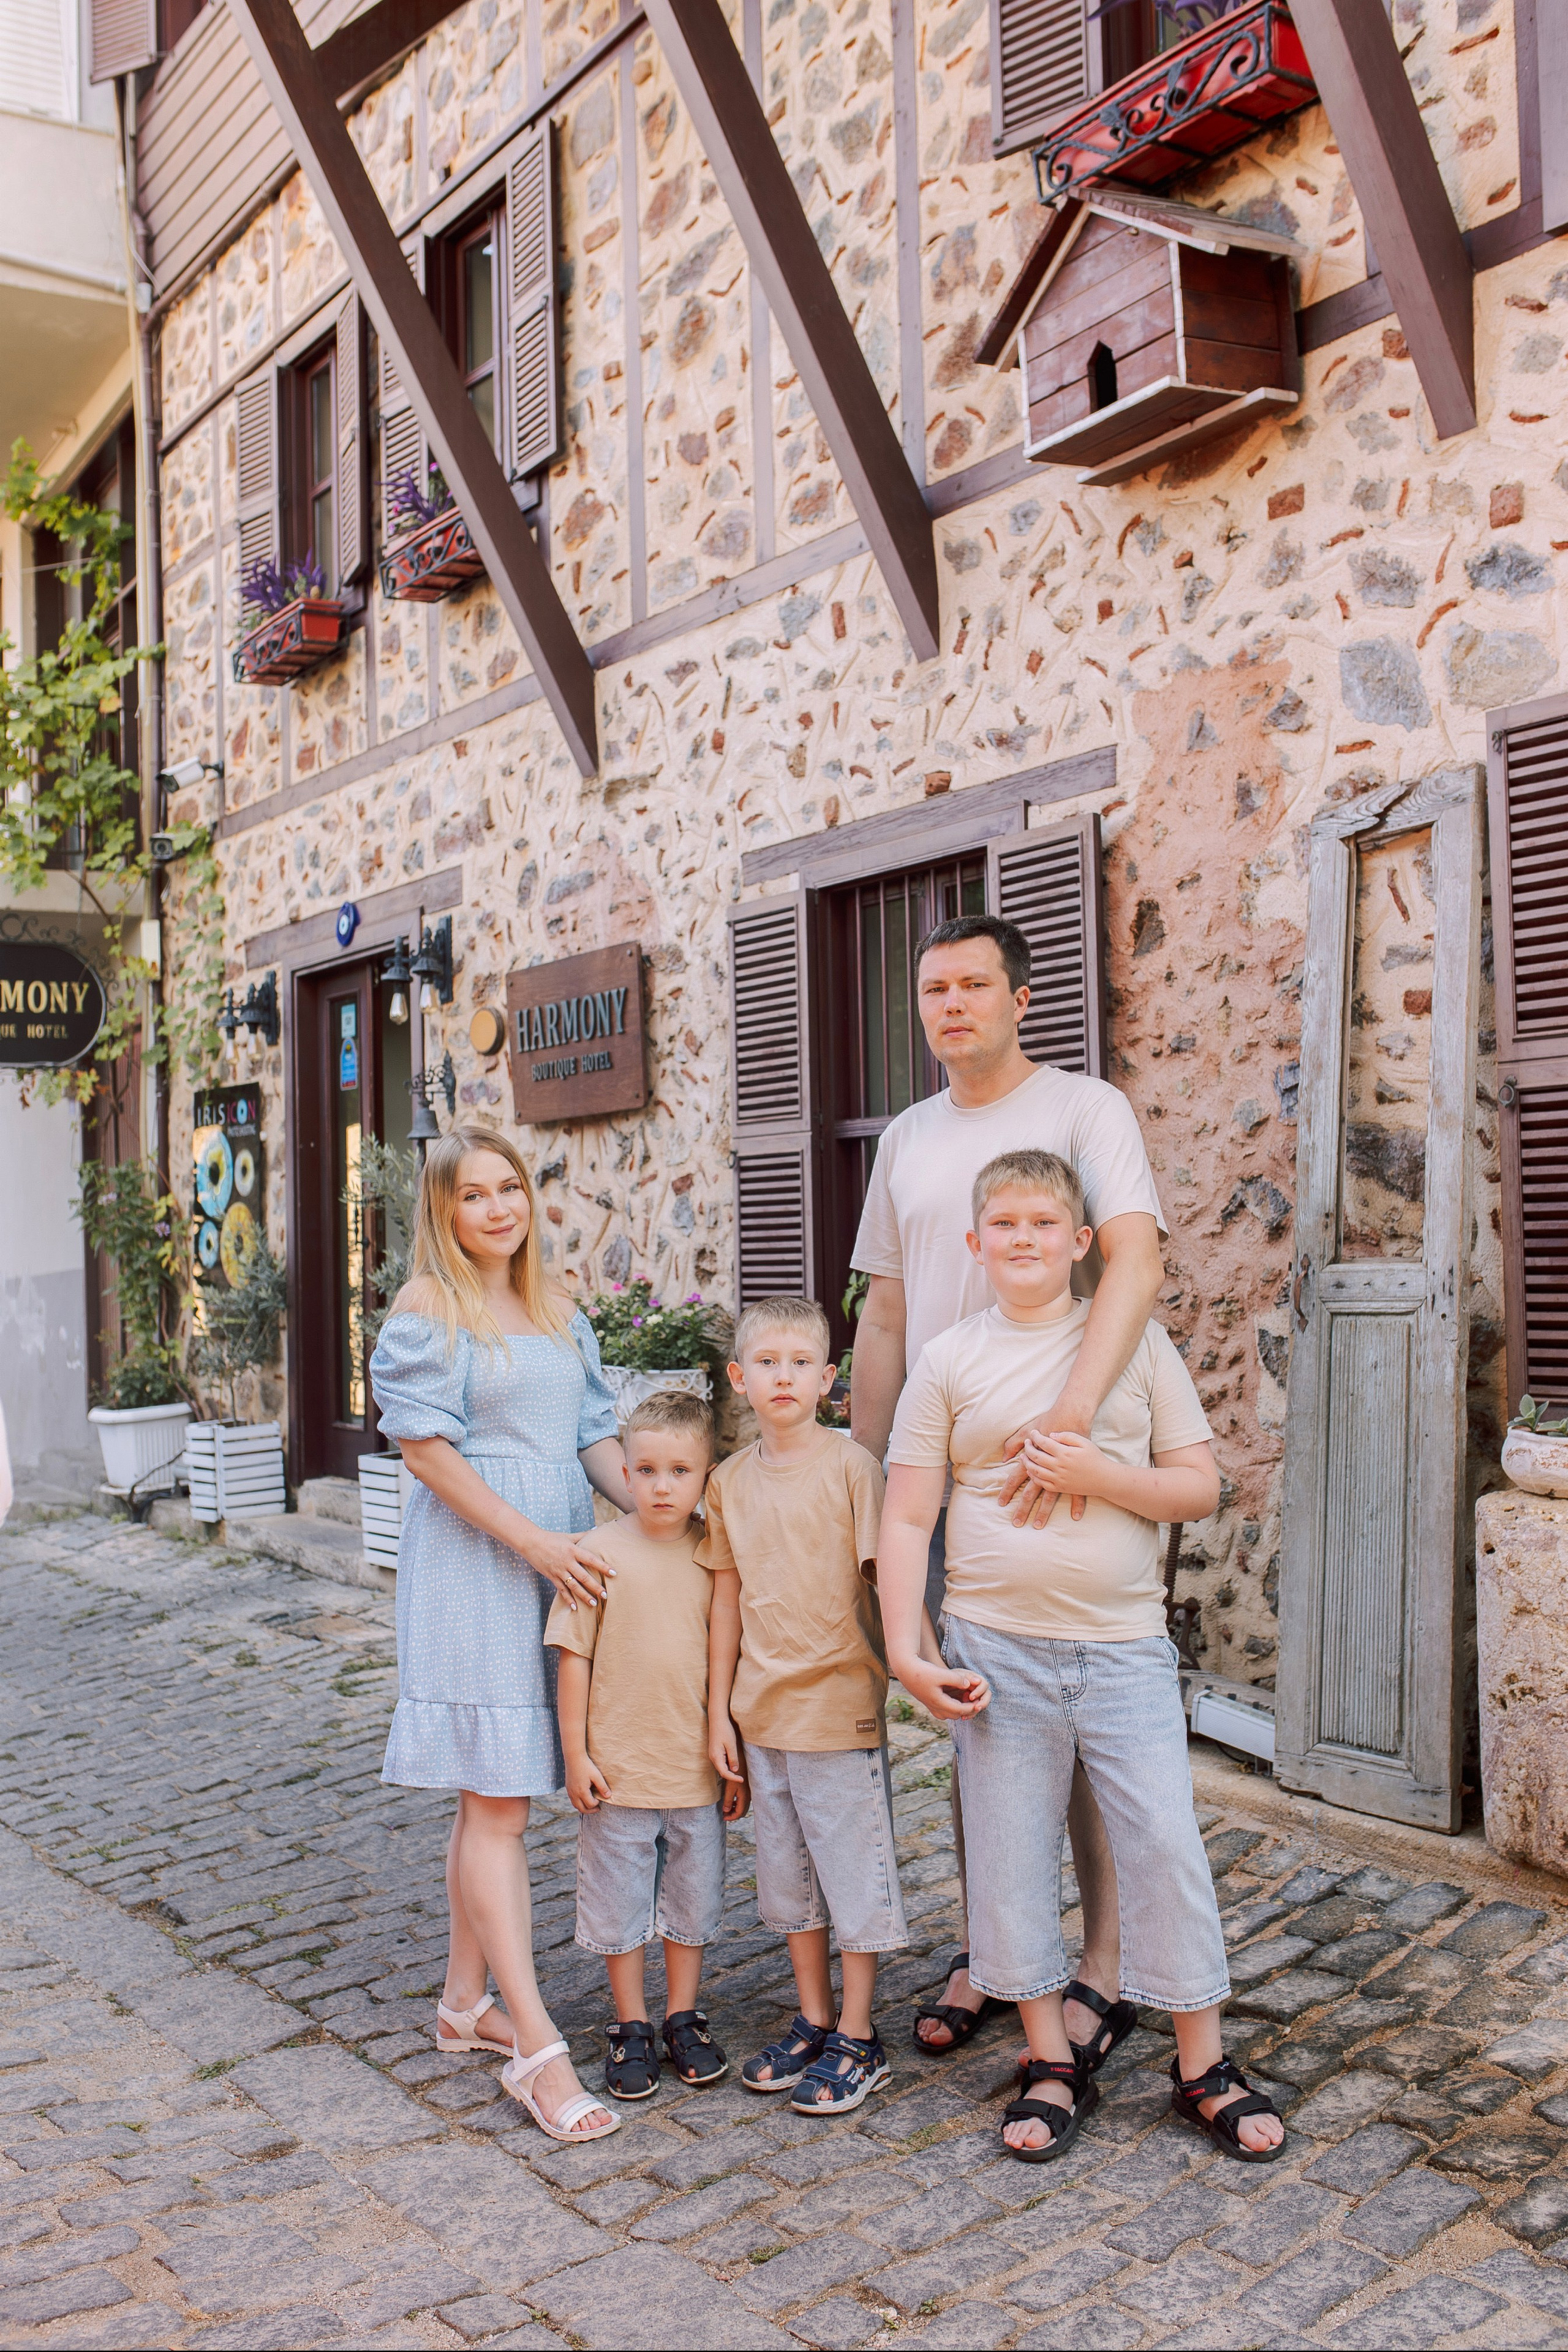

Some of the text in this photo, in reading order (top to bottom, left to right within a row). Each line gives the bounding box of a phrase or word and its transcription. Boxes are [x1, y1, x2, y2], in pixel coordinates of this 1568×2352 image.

[27, 1023, 67, 1039] HOTEL
[514, 986, 627, 1054] HARMONY
[532, 1051, 611, 1082] BOUTIQUE HOTEL
